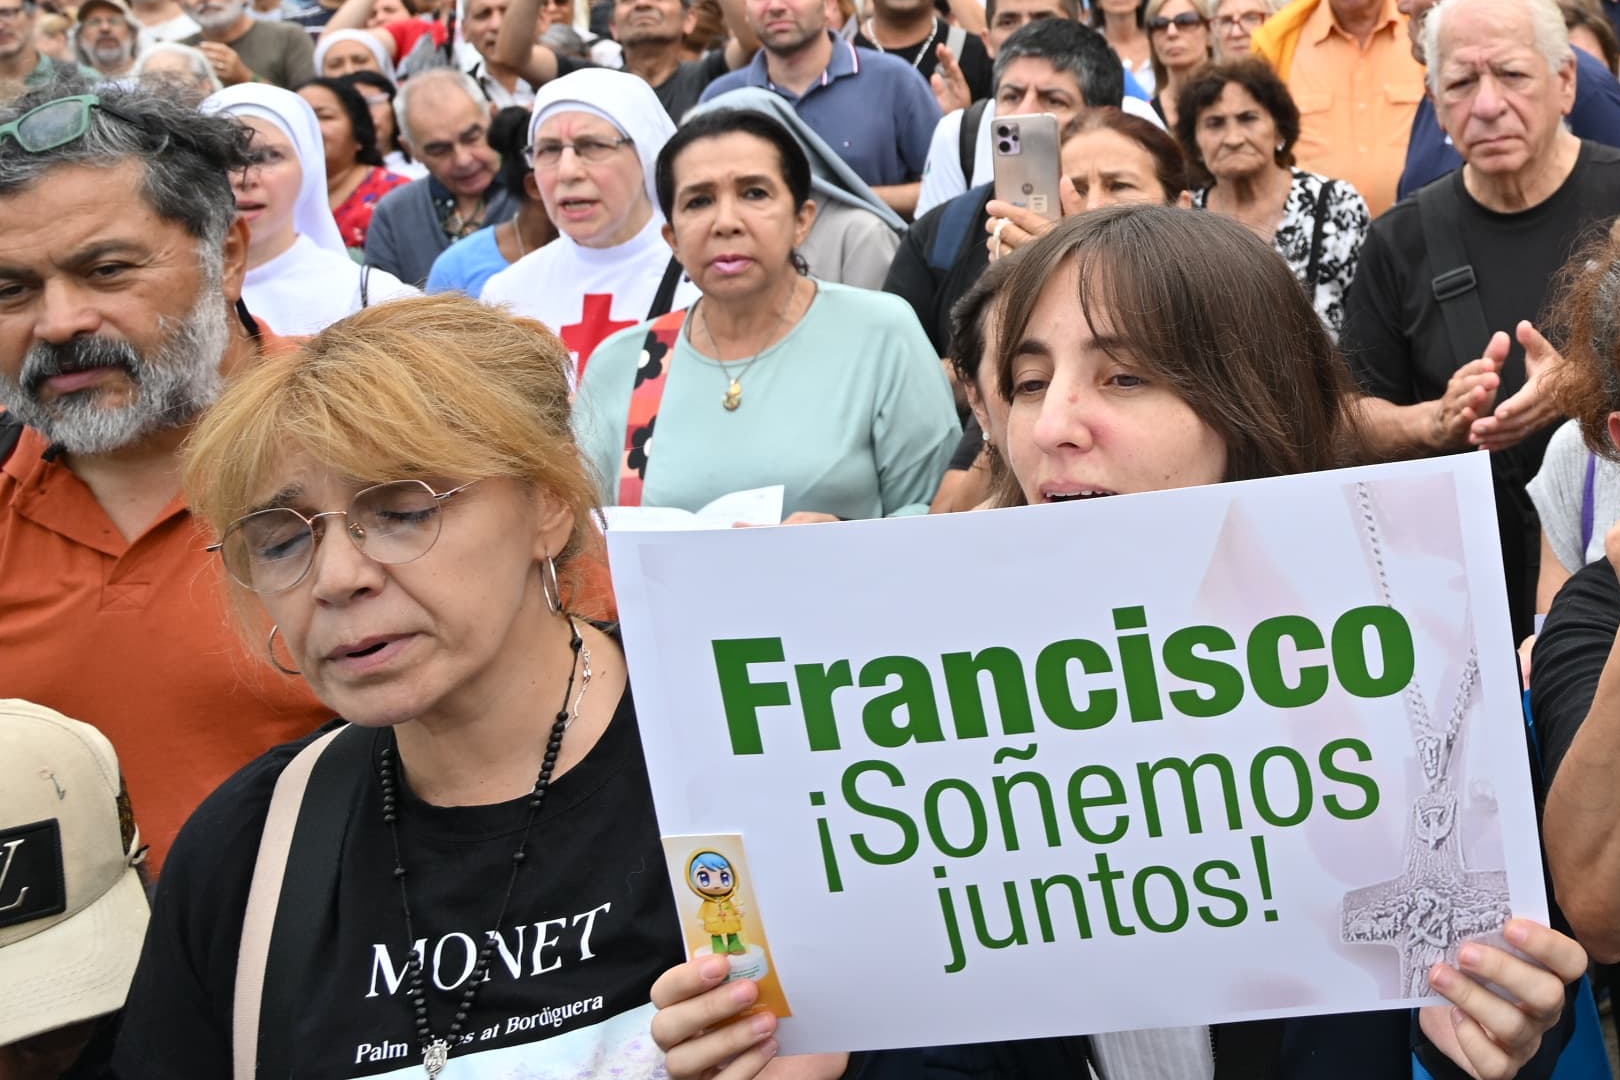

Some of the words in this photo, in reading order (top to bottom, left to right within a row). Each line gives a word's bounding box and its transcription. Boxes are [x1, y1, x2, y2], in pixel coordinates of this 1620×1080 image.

[712, 605, 1416, 756] Francisco
[809, 737, 1381, 893] ¡Soñemos
[365, 902, 612, 998] MONET
[939, 835, 1280, 974] juntos!
[354, 1040, 409, 1064] Palm
[480, 1023, 501, 1041] at
[505, 994, 604, 1028] Bordiguera
